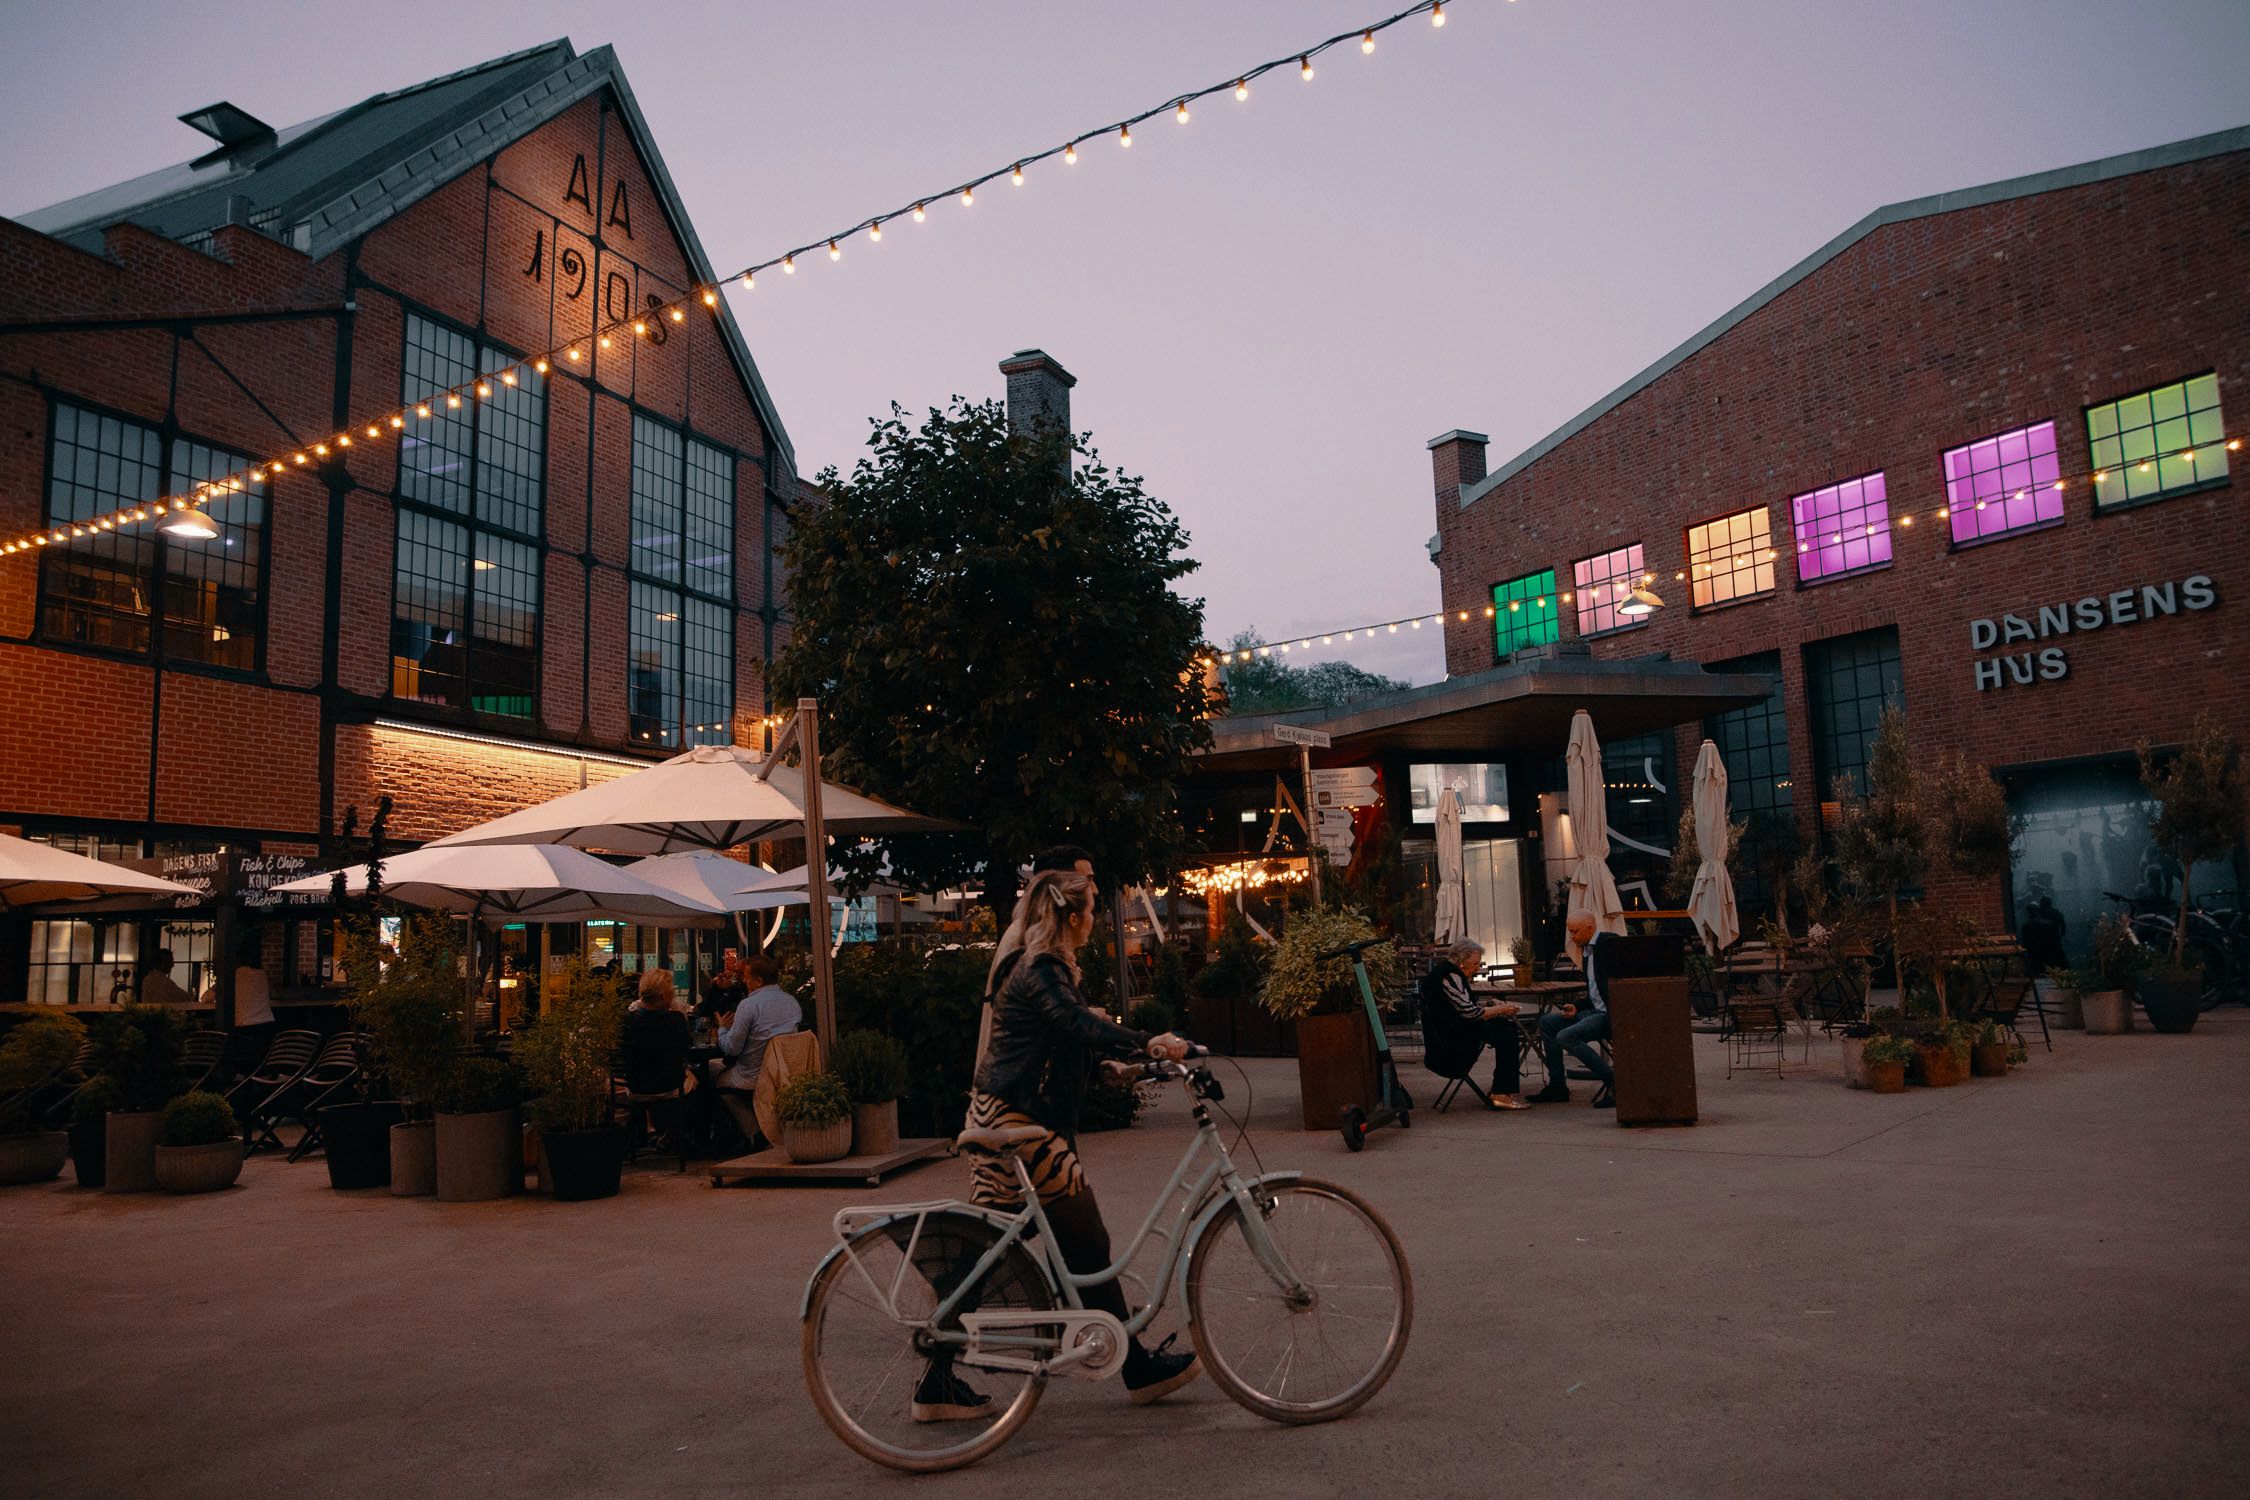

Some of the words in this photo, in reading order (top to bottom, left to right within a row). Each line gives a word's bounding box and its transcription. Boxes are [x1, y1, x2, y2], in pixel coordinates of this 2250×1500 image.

[1970, 575, 2216, 650] DANSENS
[1974, 647, 2068, 691] HUS
[162, 854, 195, 873] DAGENS
[198, 852, 217, 868] FISK
[240, 857, 264, 872] Fish
[265, 854, 274, 873] &
[276, 855, 305, 874] Chips
